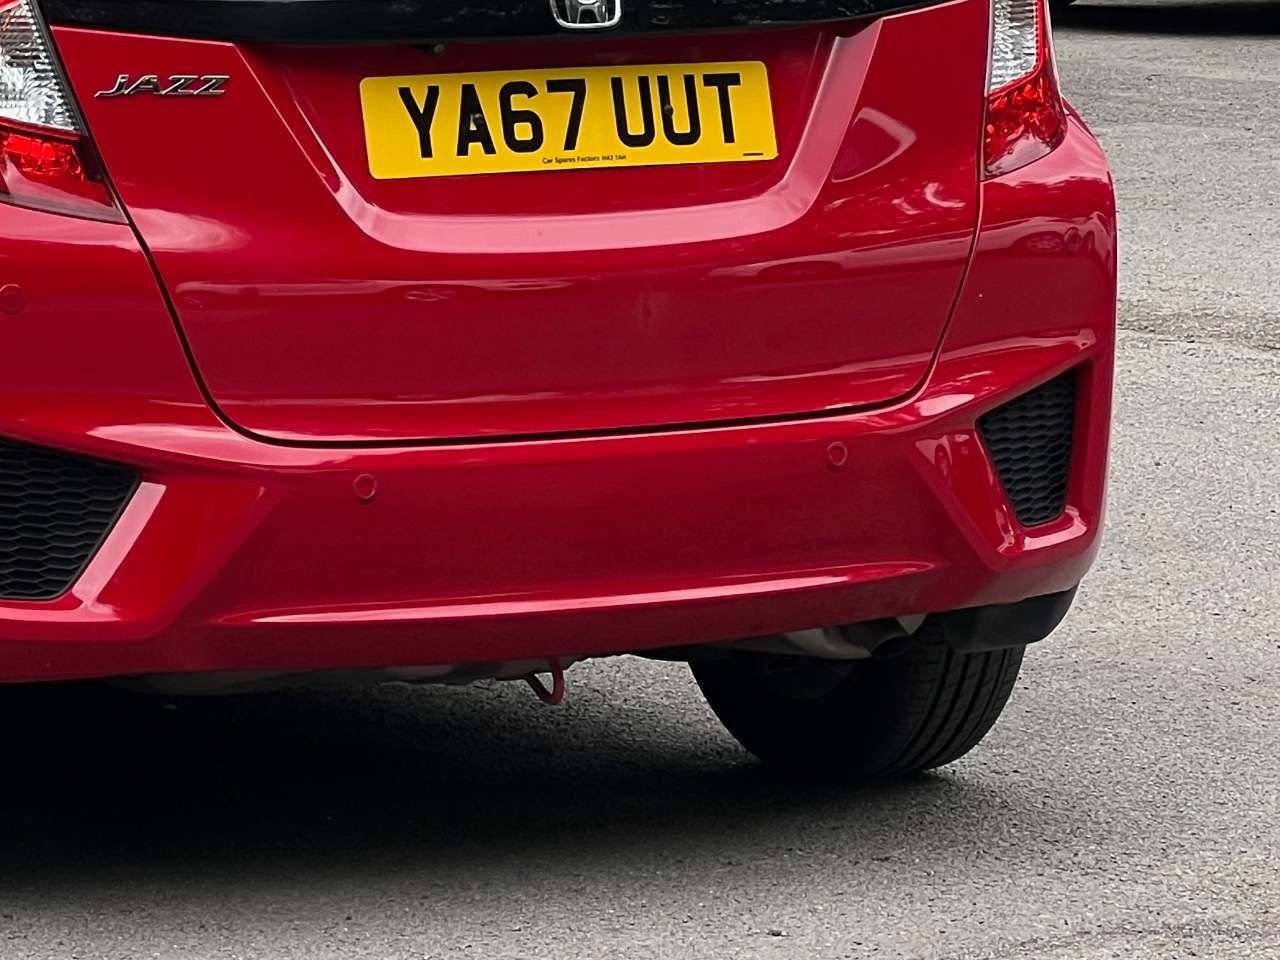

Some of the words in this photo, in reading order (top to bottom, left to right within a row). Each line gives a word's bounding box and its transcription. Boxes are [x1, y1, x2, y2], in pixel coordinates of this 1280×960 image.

[94, 74, 230, 98] JAZZ
[398, 78, 587, 159] YA67
[611, 72, 742, 149] UUT
